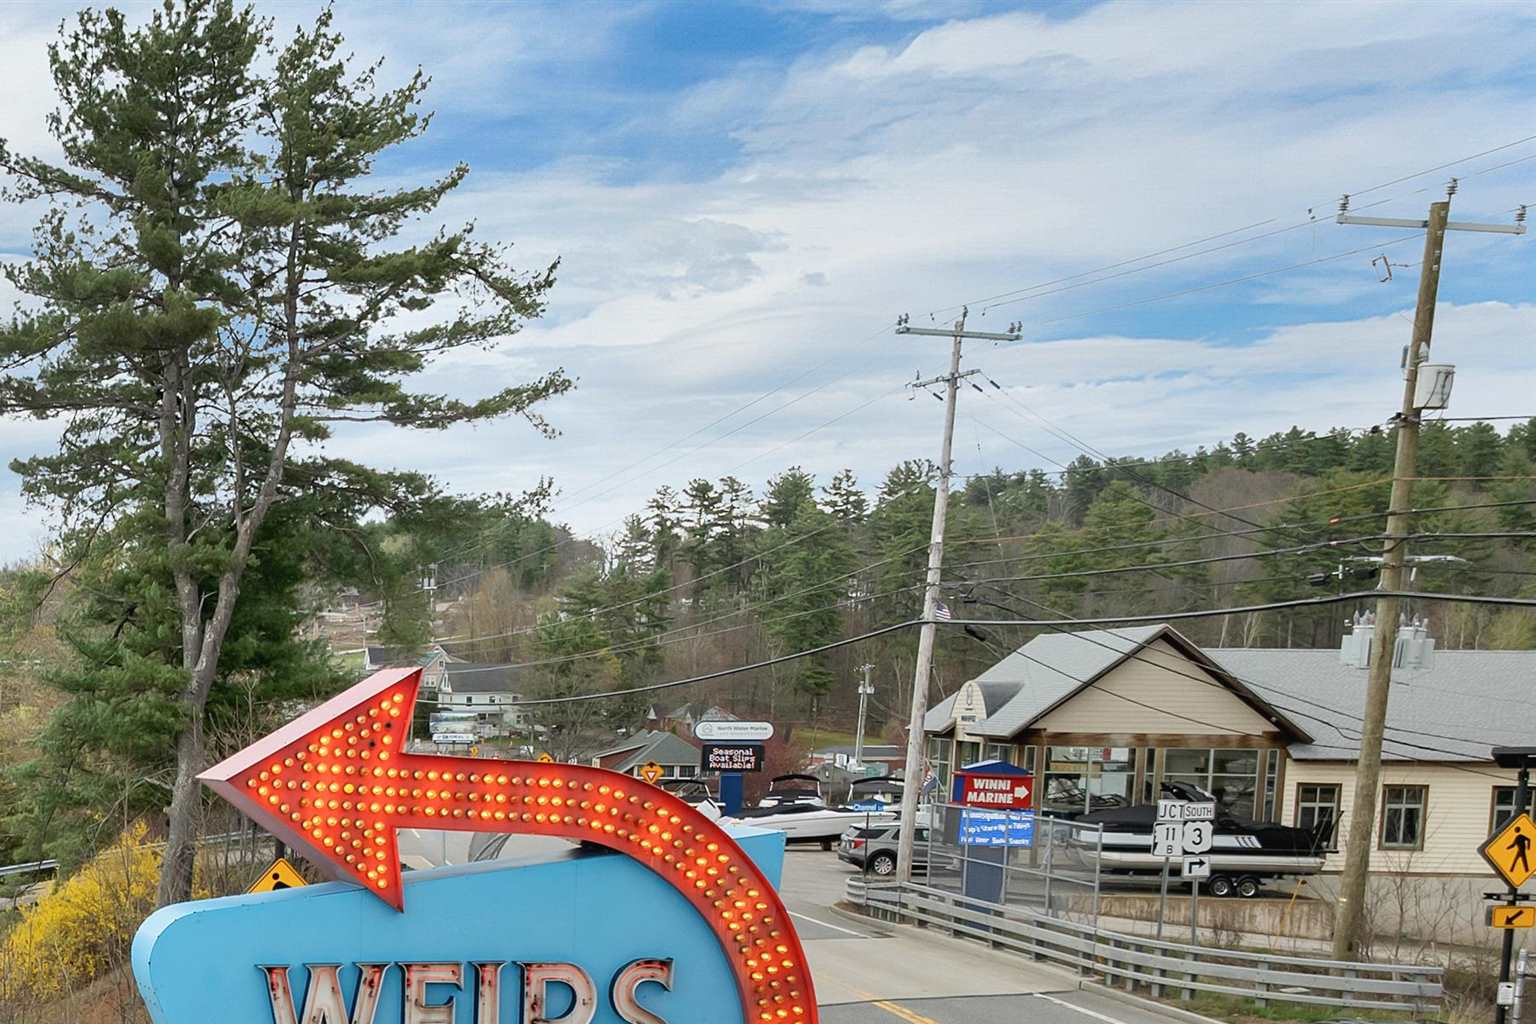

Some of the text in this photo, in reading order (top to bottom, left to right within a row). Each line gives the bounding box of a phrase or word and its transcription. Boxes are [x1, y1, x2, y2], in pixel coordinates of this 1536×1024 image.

[712, 747, 753, 756] Seasonal
[709, 754, 756, 762] Boat Slips
[709, 761, 755, 769] Available!
[973, 778, 1012, 791] WINNI
[967, 791, 1014, 804] MARINE
[1159, 804, 1184, 818] JCT
[1186, 806, 1212, 817] SOUTH
[1166, 828, 1175, 840] 11
[1192, 828, 1202, 845] 3
[1167, 845, 1173, 854] B
